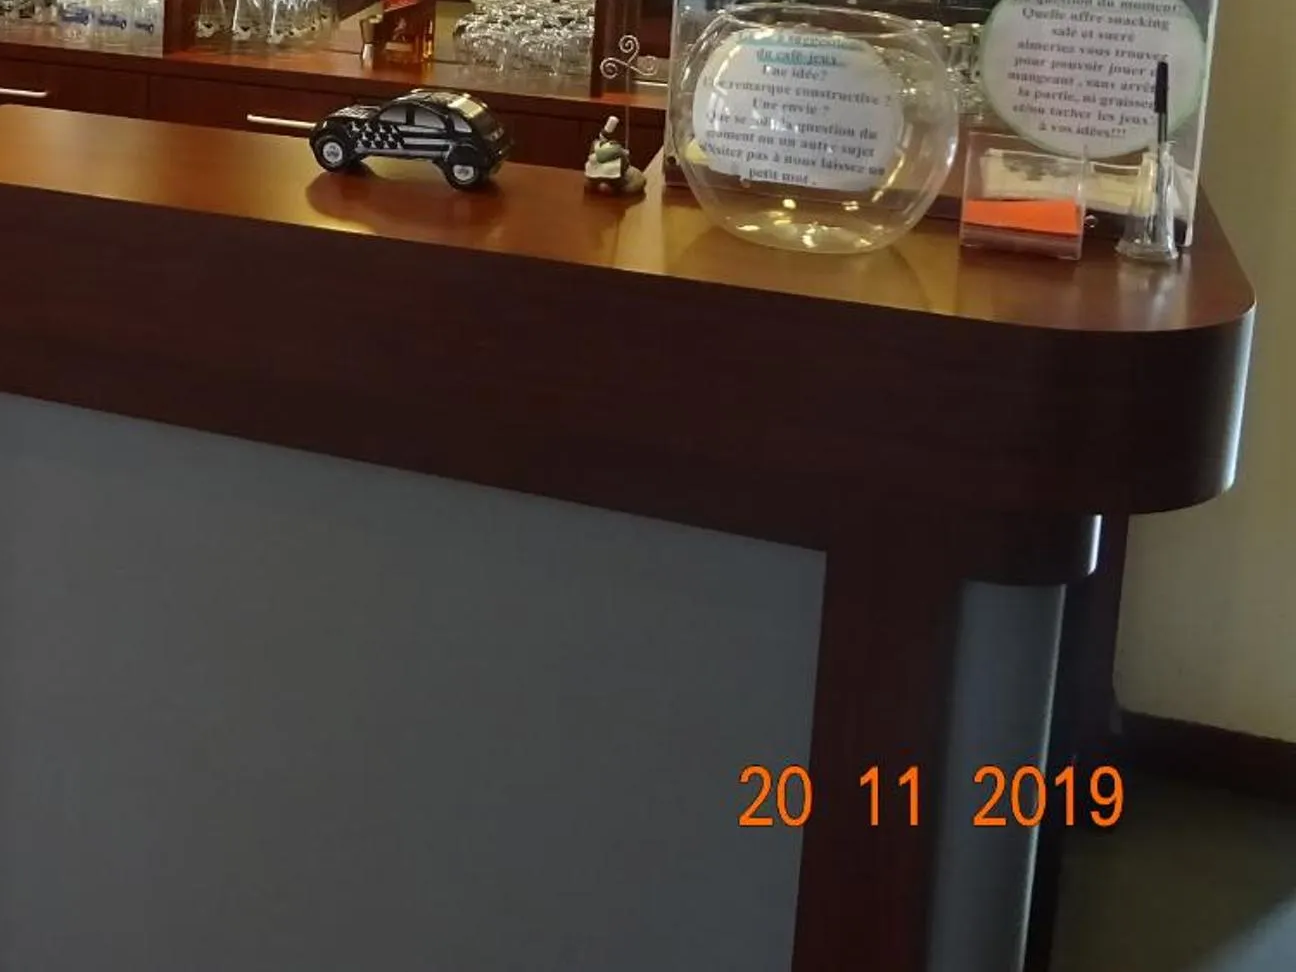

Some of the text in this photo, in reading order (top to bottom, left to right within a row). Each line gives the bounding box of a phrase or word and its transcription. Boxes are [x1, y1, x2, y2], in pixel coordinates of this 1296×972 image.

[1022, 7, 1065, 20] Quelle
[1107, 15, 1170, 32] snacking
[1015, 56, 1045, 68] pour
[1108, 62, 1146, 77] jouer
[795, 87, 879, 105] constructive
[797, 123, 856, 138] question
[860, 128, 879, 140] du
[746, 149, 769, 163] pas
